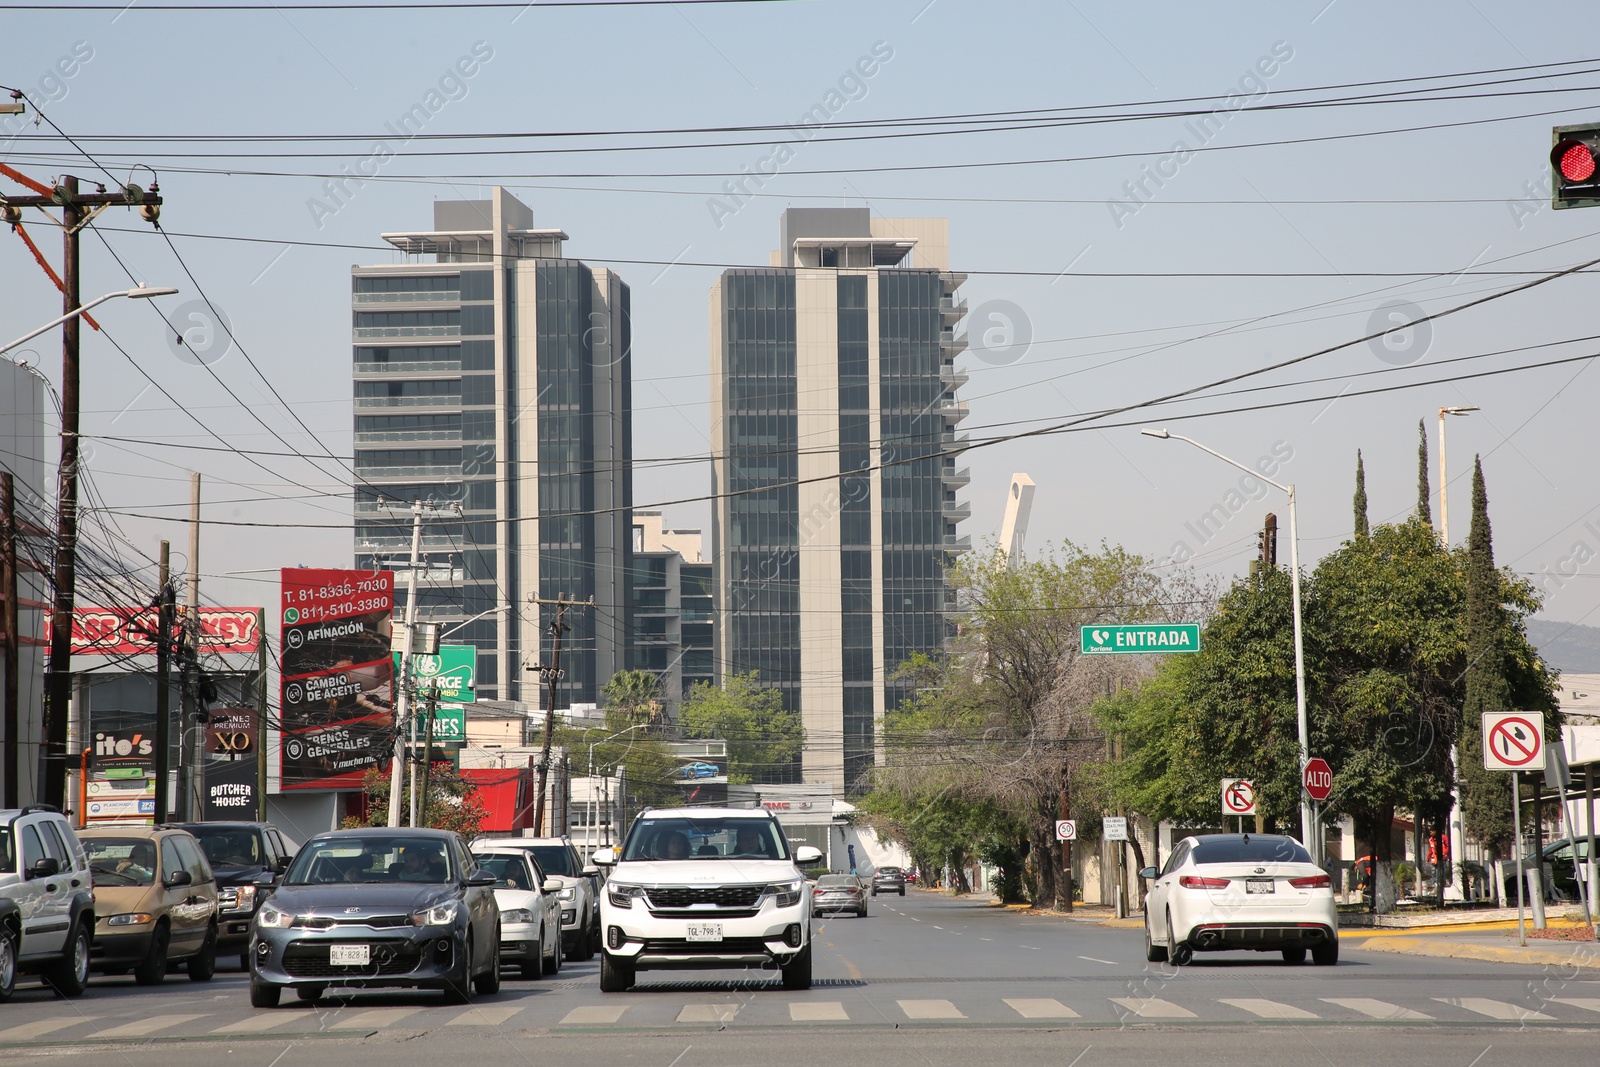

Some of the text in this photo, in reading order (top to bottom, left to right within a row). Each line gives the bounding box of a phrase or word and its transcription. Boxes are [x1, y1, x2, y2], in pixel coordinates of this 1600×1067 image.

[284, 578, 388, 603] T. 81-8336-7030
[301, 596, 388, 619] 811-510-3380
[307, 621, 364, 641] AFINACIÓN
[1116, 631, 1190, 647] ENTRADA
[306, 675, 347, 691] CAMBIO
[307, 683, 362, 702] DE ACEITE
[95, 733, 153, 756] ito's
[214, 732, 250, 750] XO
[339, 757, 363, 768] mucho
[1305, 770, 1331, 788] ALTO
[210, 783, 251, 797] BUTCHER
[331, 950, 368, 959] RLY-828-A
